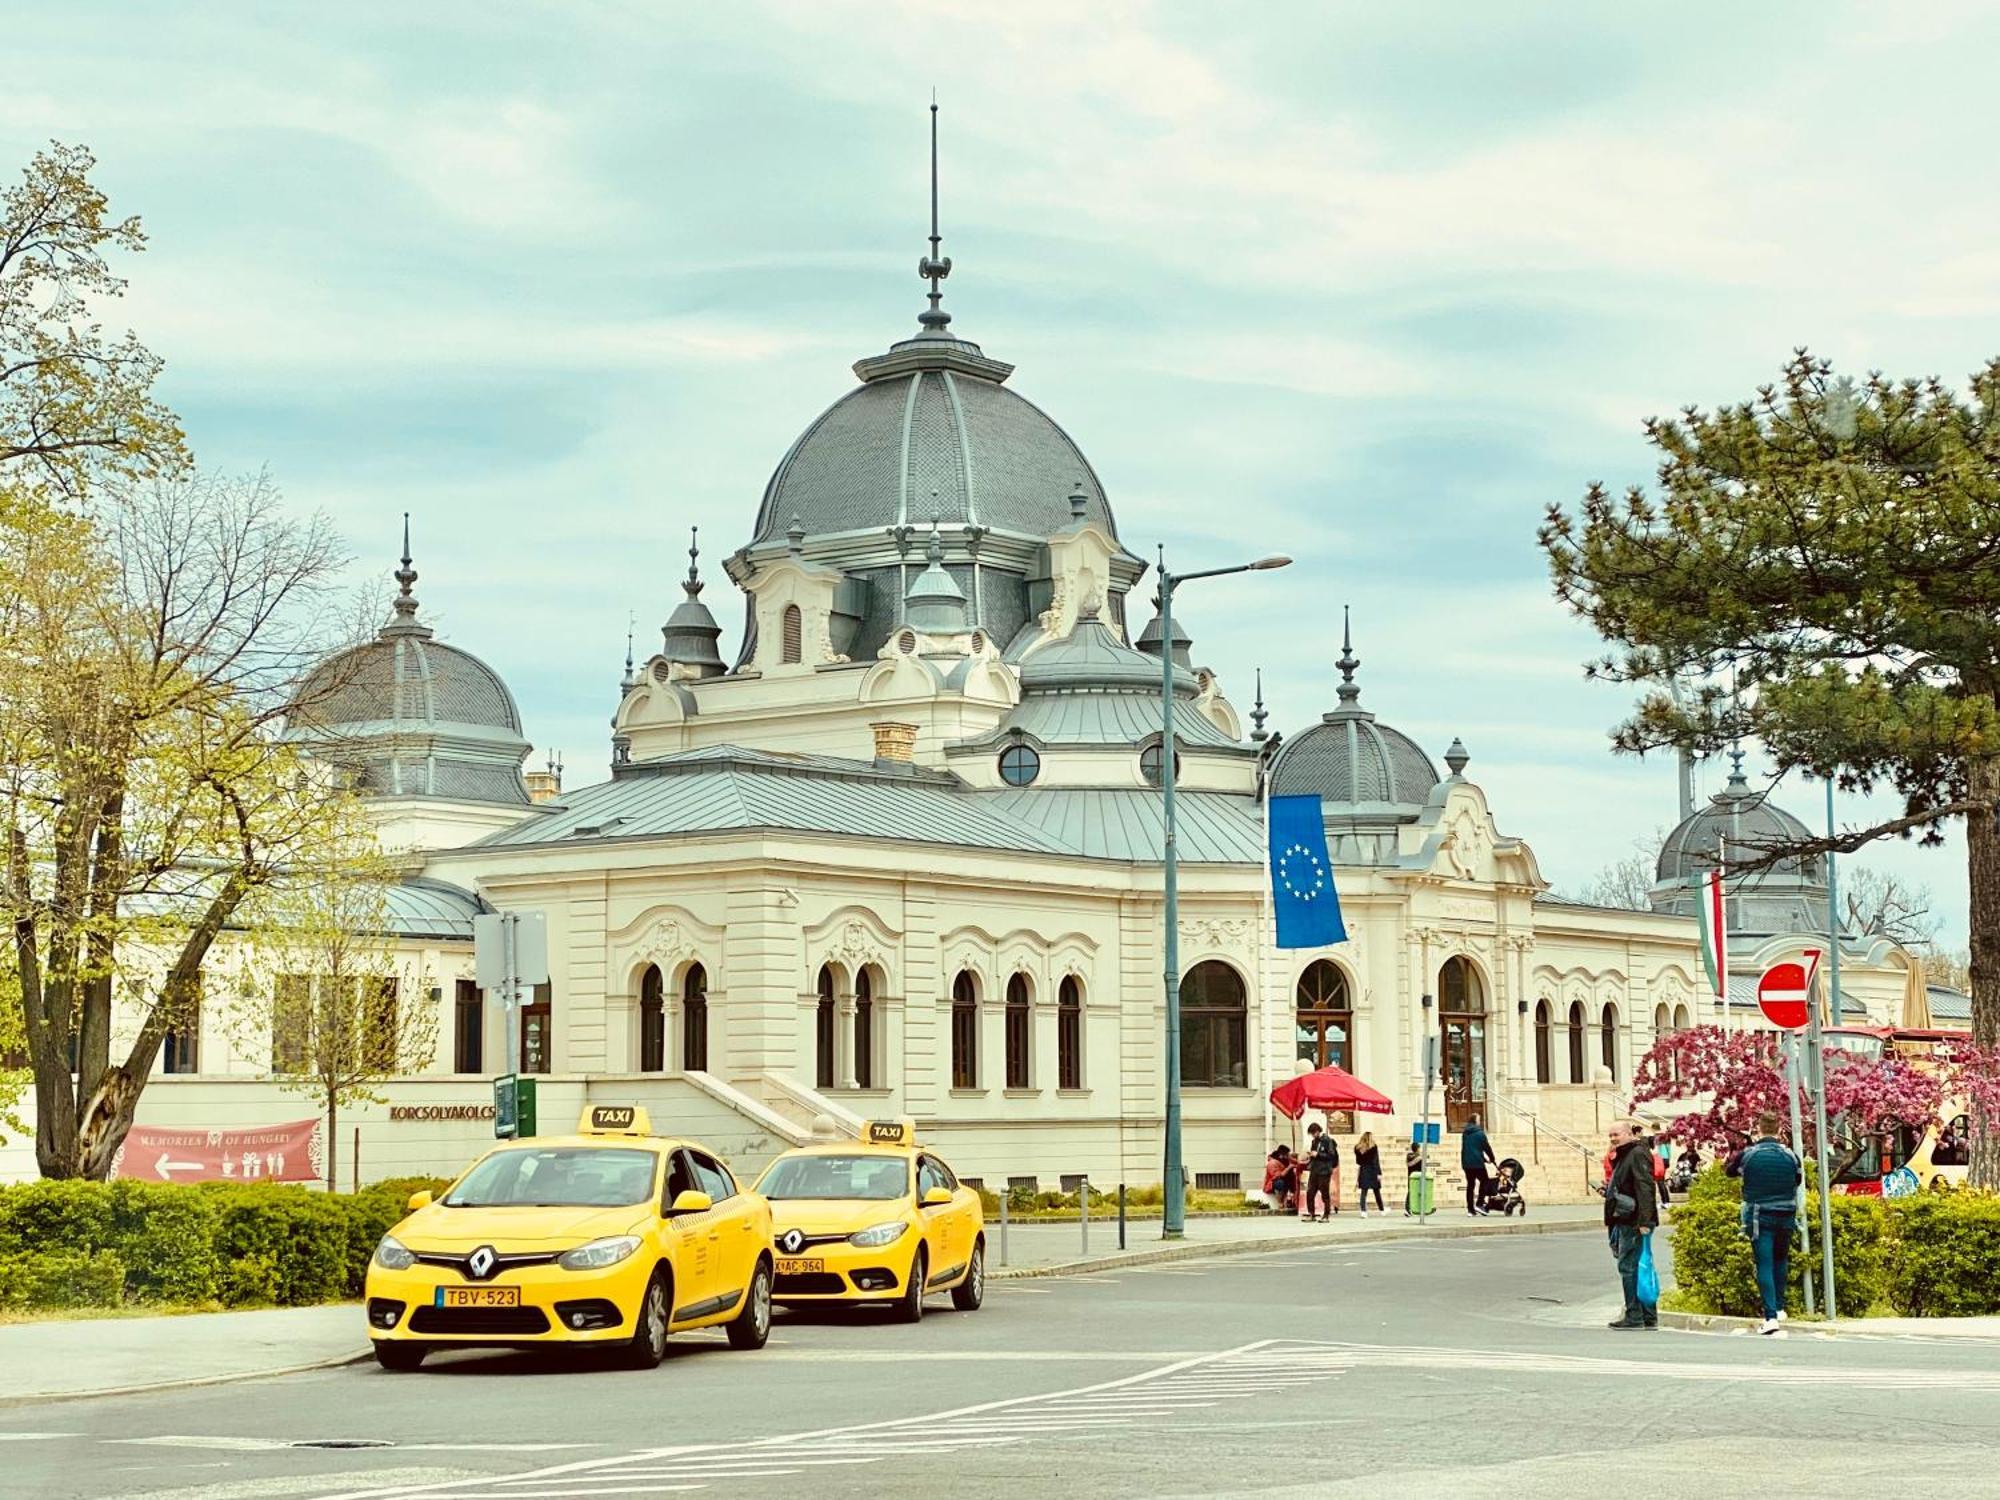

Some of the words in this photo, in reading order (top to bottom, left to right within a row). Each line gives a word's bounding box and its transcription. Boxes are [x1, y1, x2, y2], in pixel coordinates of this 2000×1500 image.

[597, 1110, 631, 1123] TAXI
[873, 1127, 901, 1138] TAXI
[140, 1134, 201, 1147] MEMORIES
[225, 1136, 240, 1145] OF
[243, 1133, 291, 1146] HUNGARY
[447, 1290, 516, 1305] TBV-523
